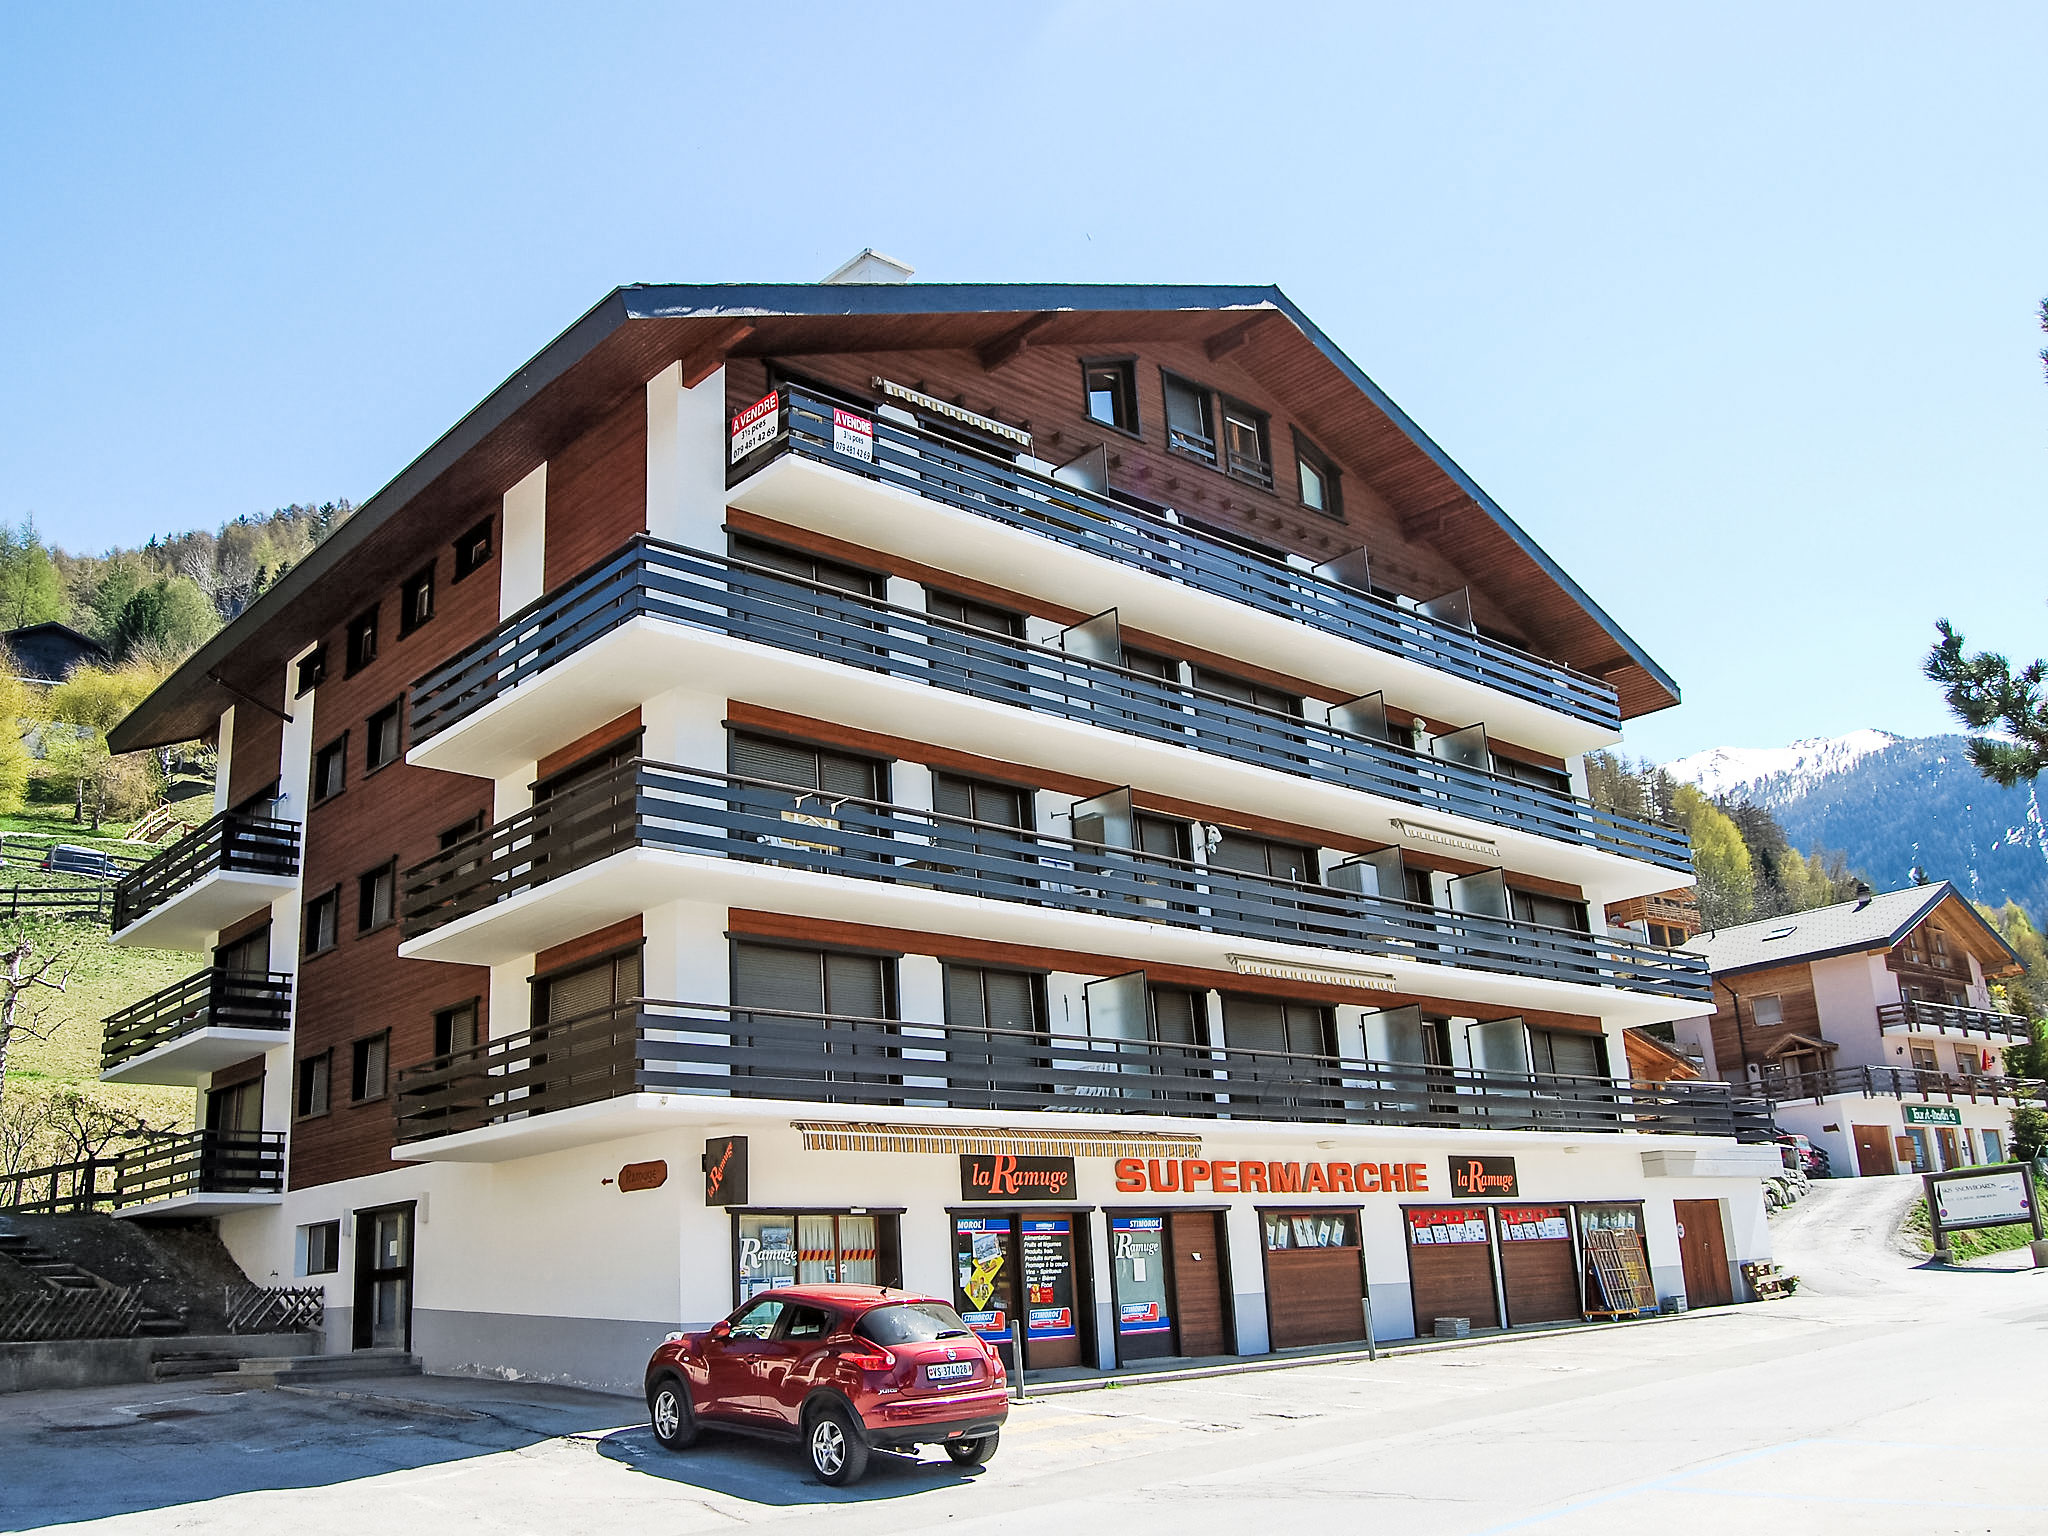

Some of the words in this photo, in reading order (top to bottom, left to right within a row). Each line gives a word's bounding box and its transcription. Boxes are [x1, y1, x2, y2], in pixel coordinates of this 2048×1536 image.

[733, 420, 740, 433] A
[740, 394, 777, 427] VENDRE
[751, 419, 767, 435] pces
[835, 412, 842, 425] A
[842, 414, 872, 435] VENDRE
[733, 444, 744, 459] 079
[744, 437, 756, 453] 481
[757, 431, 766, 443] 42
[766, 425, 776, 438] 69
[835, 442, 846, 453] 079
[846, 444, 856, 456] 481
[856, 447, 864, 459] 42
[864, 450, 871, 461] 69
[852, 434, 864, 445] pces
[709, 1141, 733, 1191] Ramuge
[972, 1163, 990, 1186] la
[988, 1154, 1068, 1194] Ramuge
[1115, 1157, 1430, 1193] SUPERMARCHE
[1457, 1168, 1468, 1187] la
[1467, 1160, 1514, 1193] Ramuge
[1129, 1219, 1160, 1228] STIMOROL
[740, 1238, 798, 1269] Ramuge
[1115, 1233, 1159, 1259] Ramuge
[932, 1367, 942, 1377] VS
